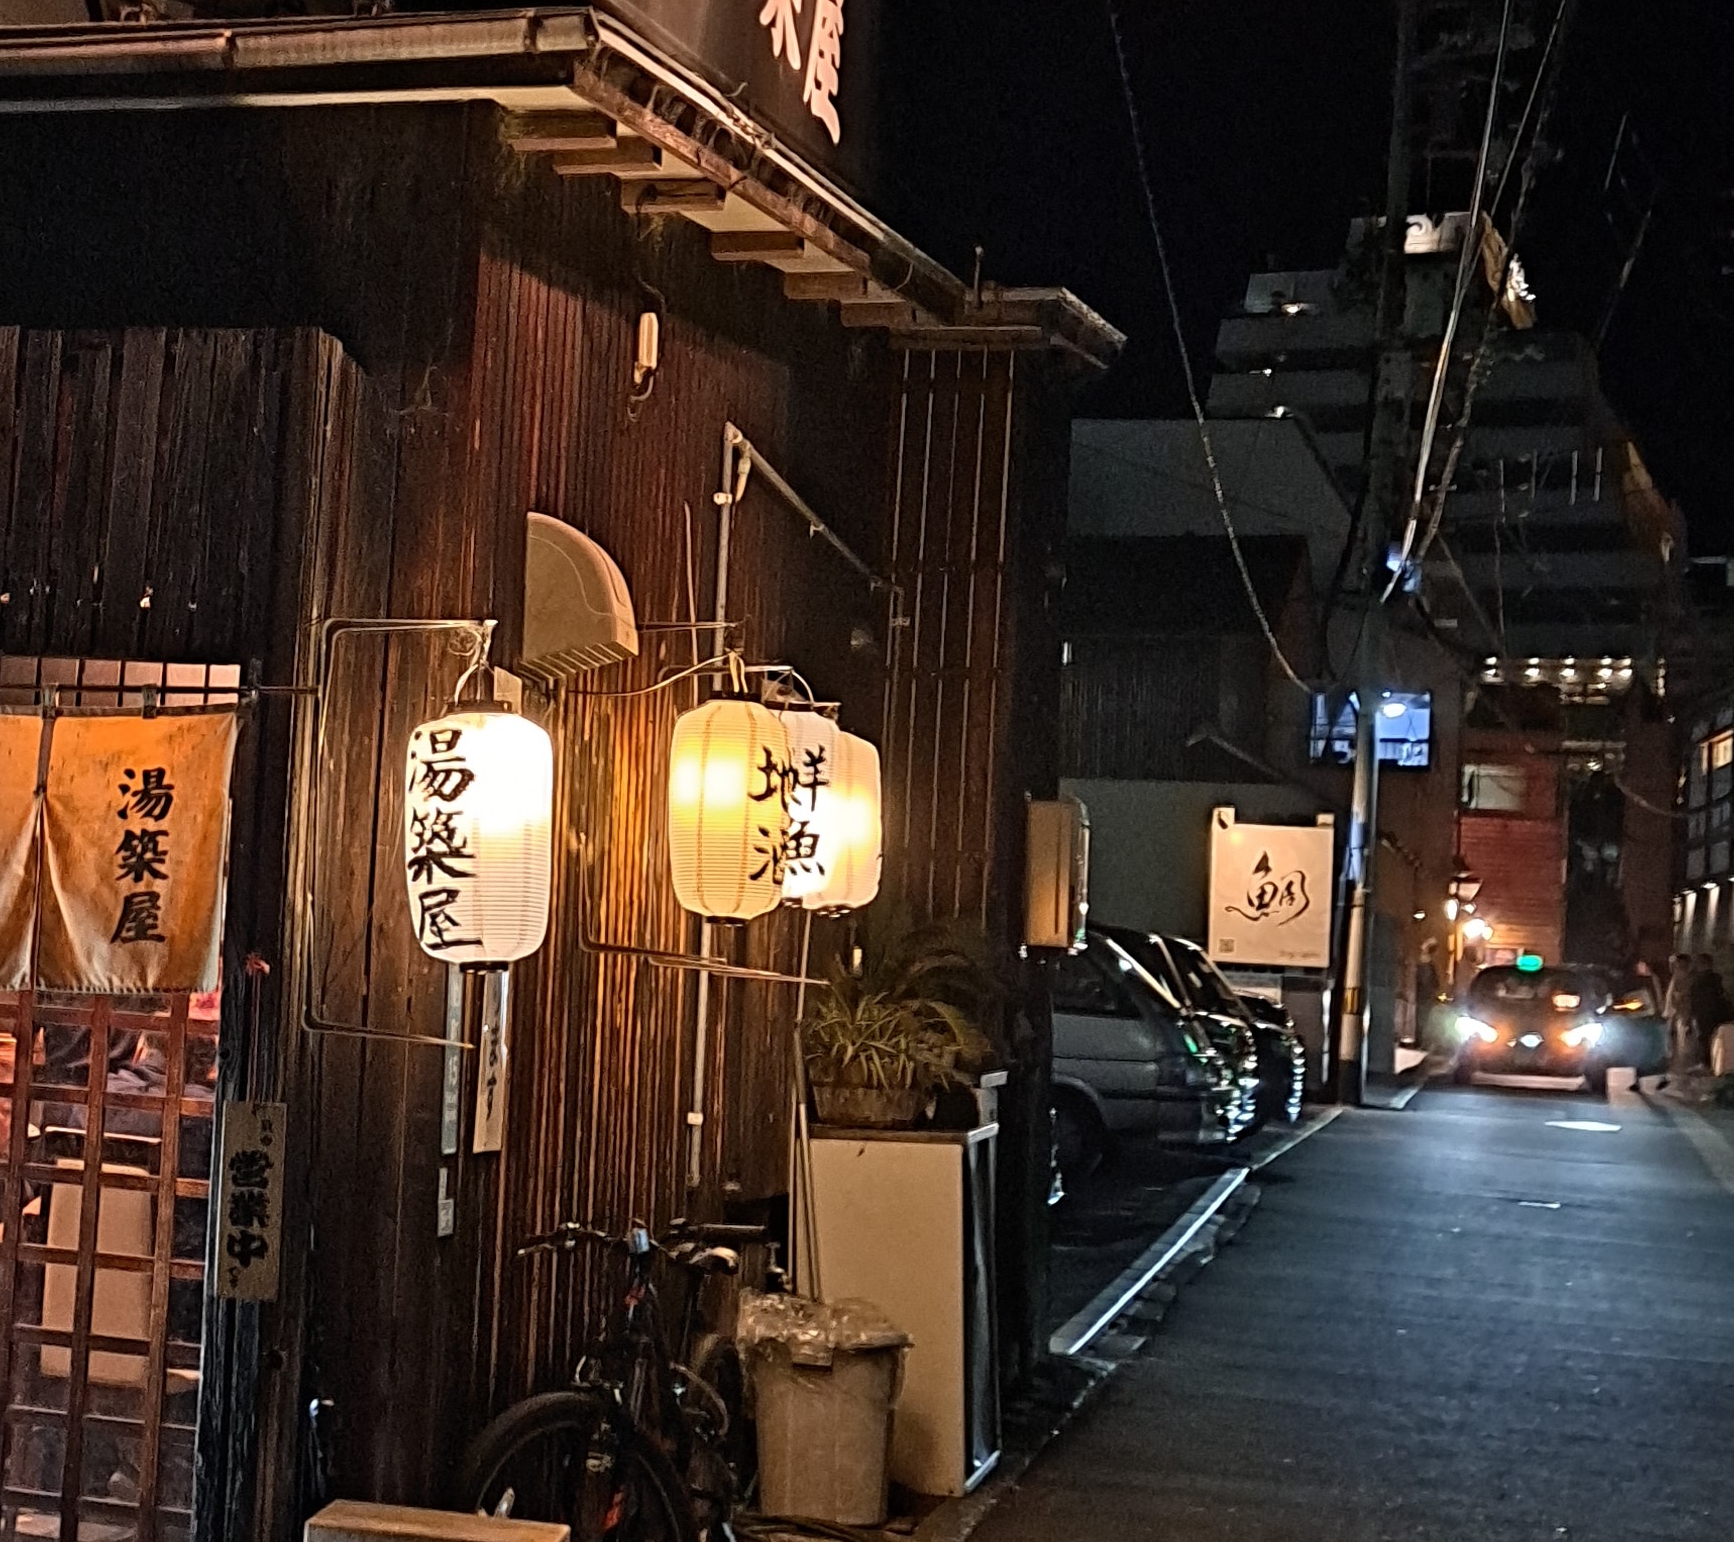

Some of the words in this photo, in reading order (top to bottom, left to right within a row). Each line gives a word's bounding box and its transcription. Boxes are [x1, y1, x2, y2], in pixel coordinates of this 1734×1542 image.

[110, 767, 174, 944] 湯築屋
[407, 729, 483, 951] 湯築屋
